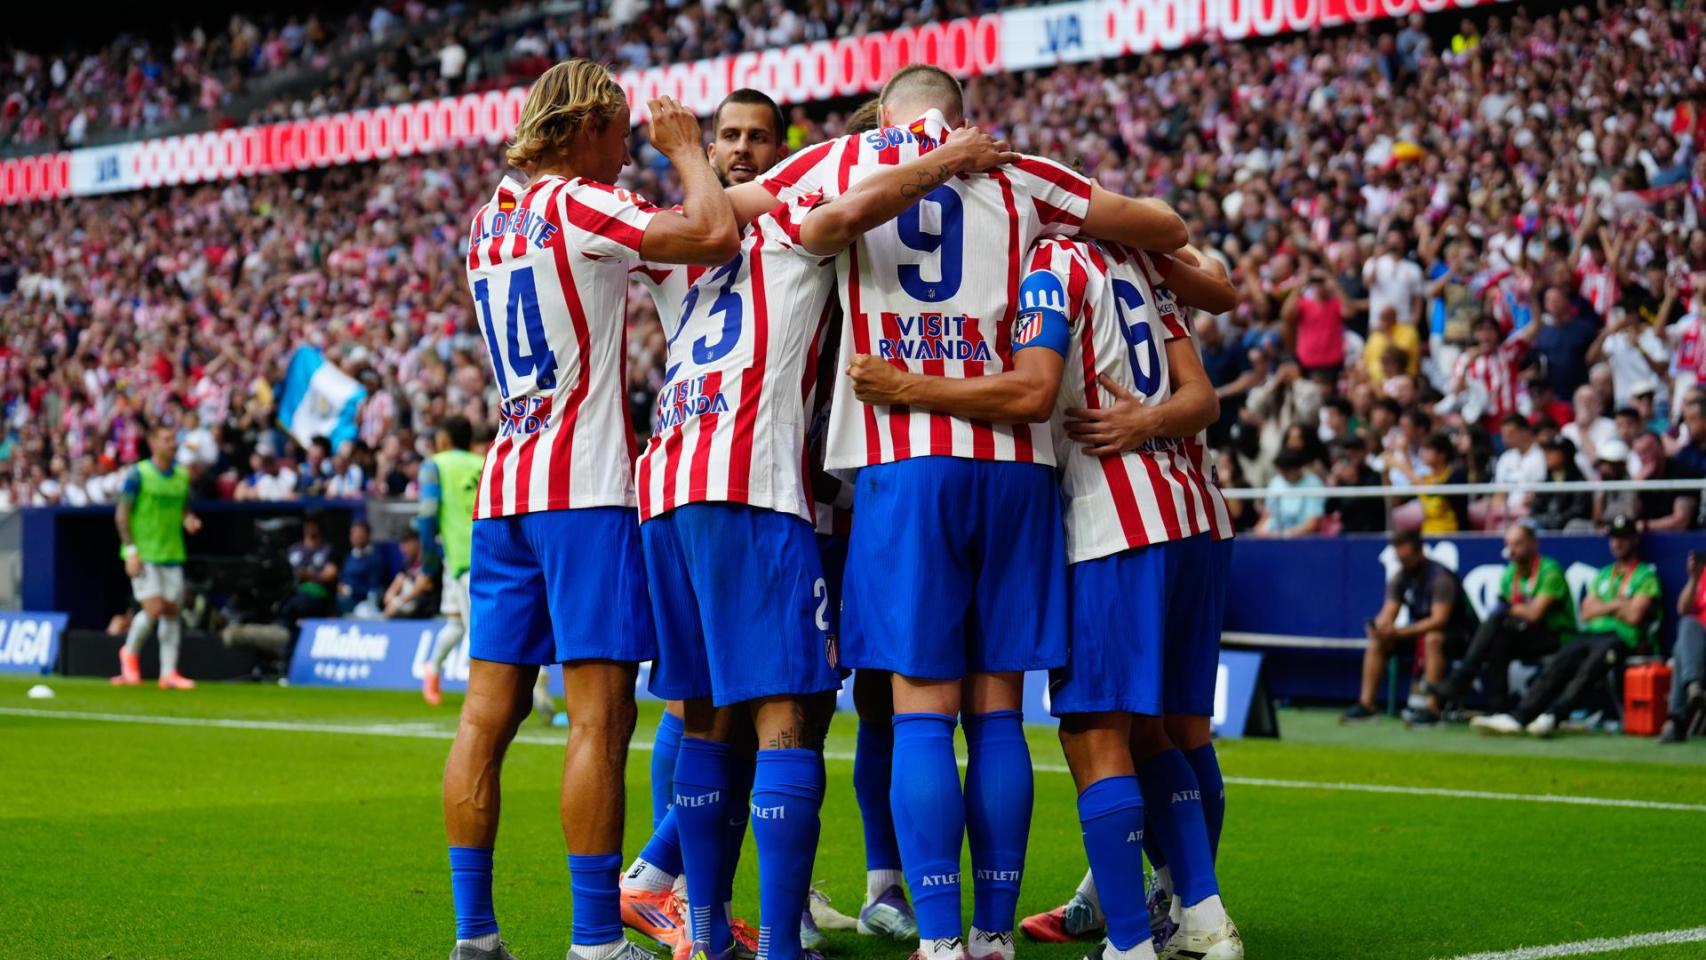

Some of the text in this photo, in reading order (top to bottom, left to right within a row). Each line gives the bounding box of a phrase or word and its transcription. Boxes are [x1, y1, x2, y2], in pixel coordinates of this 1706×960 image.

[897, 184, 964, 303] 9
[474, 266, 559, 399] 14
[896, 315, 967, 337] VISIT
[1111, 278, 1162, 398] 6
[879, 339, 992, 362] RWANDA
[661, 375, 707, 408] VISIT
[656, 393, 729, 433] WANDA
[675, 790, 720, 808] ATLETI
[977, 868, 1020, 882] ATLETI
